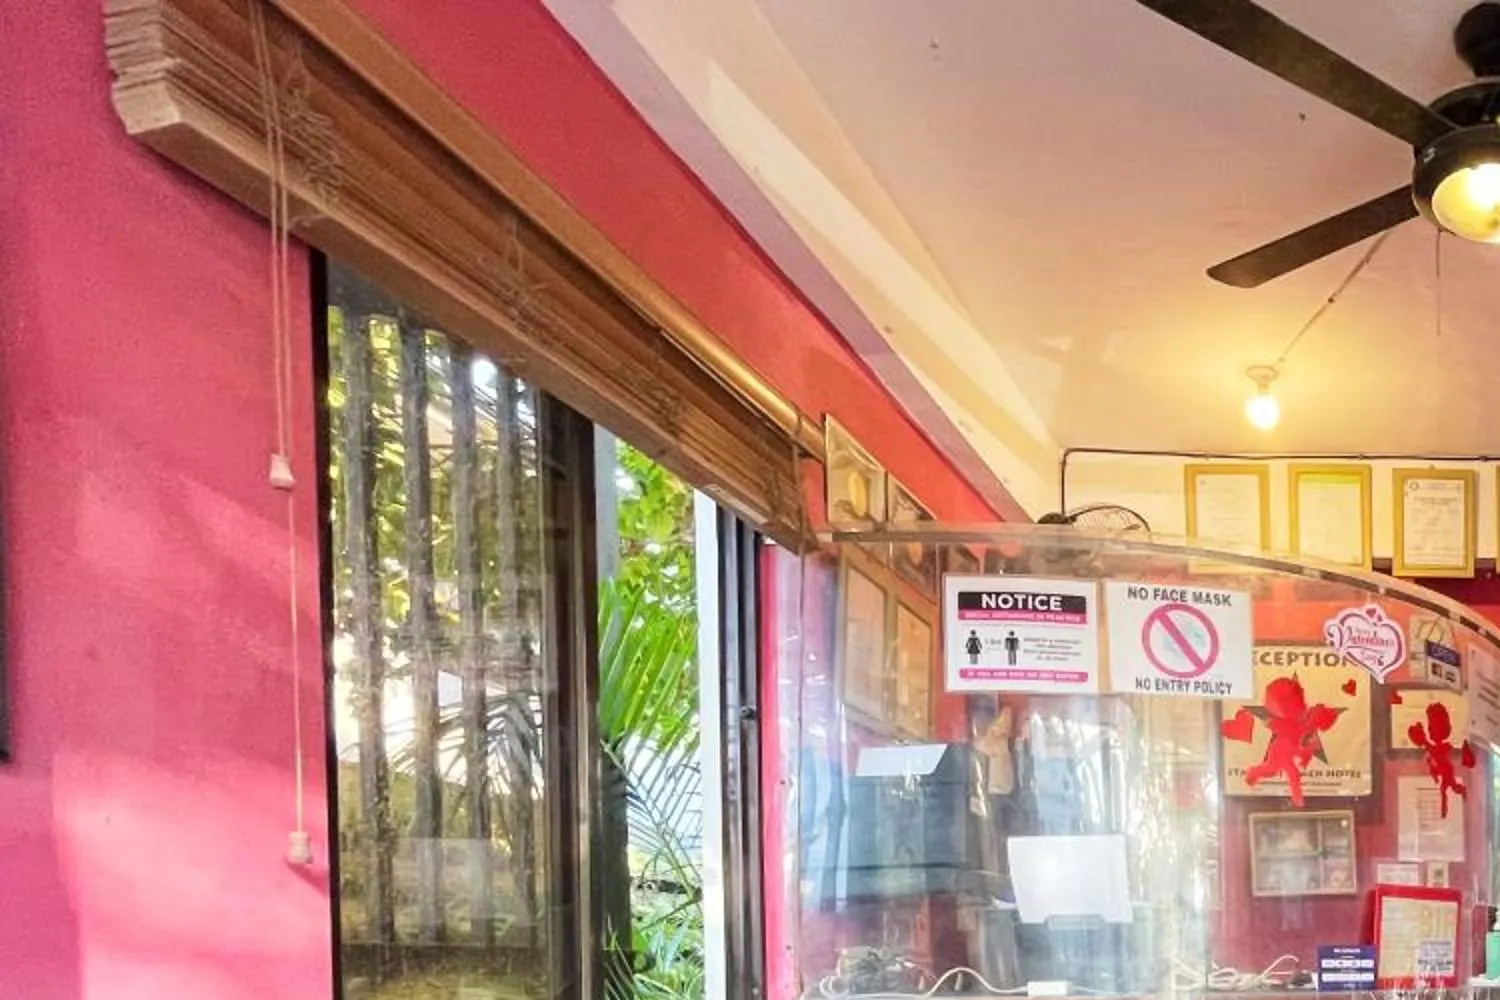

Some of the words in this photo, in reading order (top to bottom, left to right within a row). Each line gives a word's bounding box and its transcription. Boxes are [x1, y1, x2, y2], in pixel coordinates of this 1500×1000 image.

[981, 593, 1063, 611] NOTICE
[1128, 587, 1149, 600] NO
[1153, 588, 1188, 602] FACE
[1192, 592, 1232, 607] MASK
[1135, 677, 1151, 690] NO
[1155, 678, 1190, 692] ENTRY
[1194, 681, 1232, 695] POLICY
